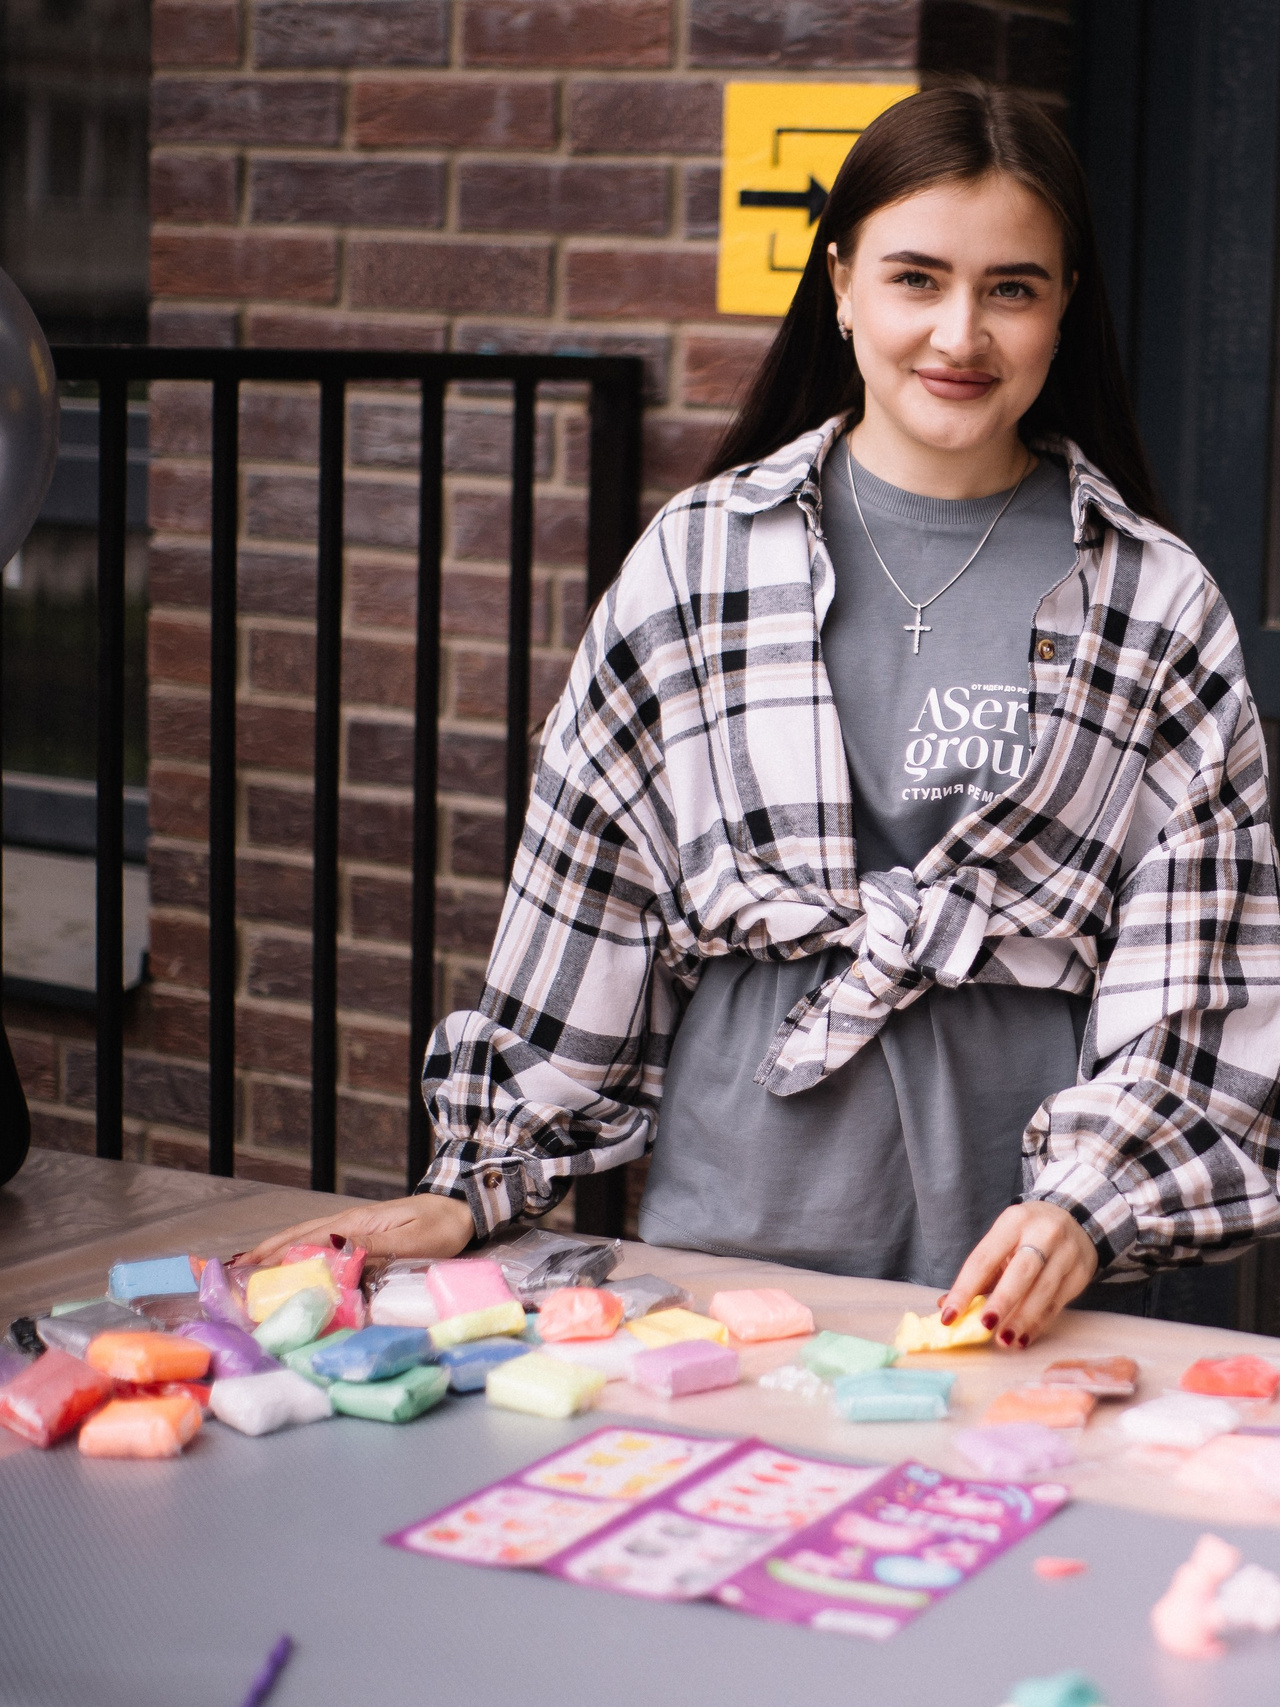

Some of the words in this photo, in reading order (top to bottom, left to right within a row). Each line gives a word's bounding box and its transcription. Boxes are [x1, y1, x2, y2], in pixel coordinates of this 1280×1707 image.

[983, 684, 1003, 692] ИДЕИ
[904, 733, 1032, 782] grou
[902, 784, 963, 801] СТУДИЯ
